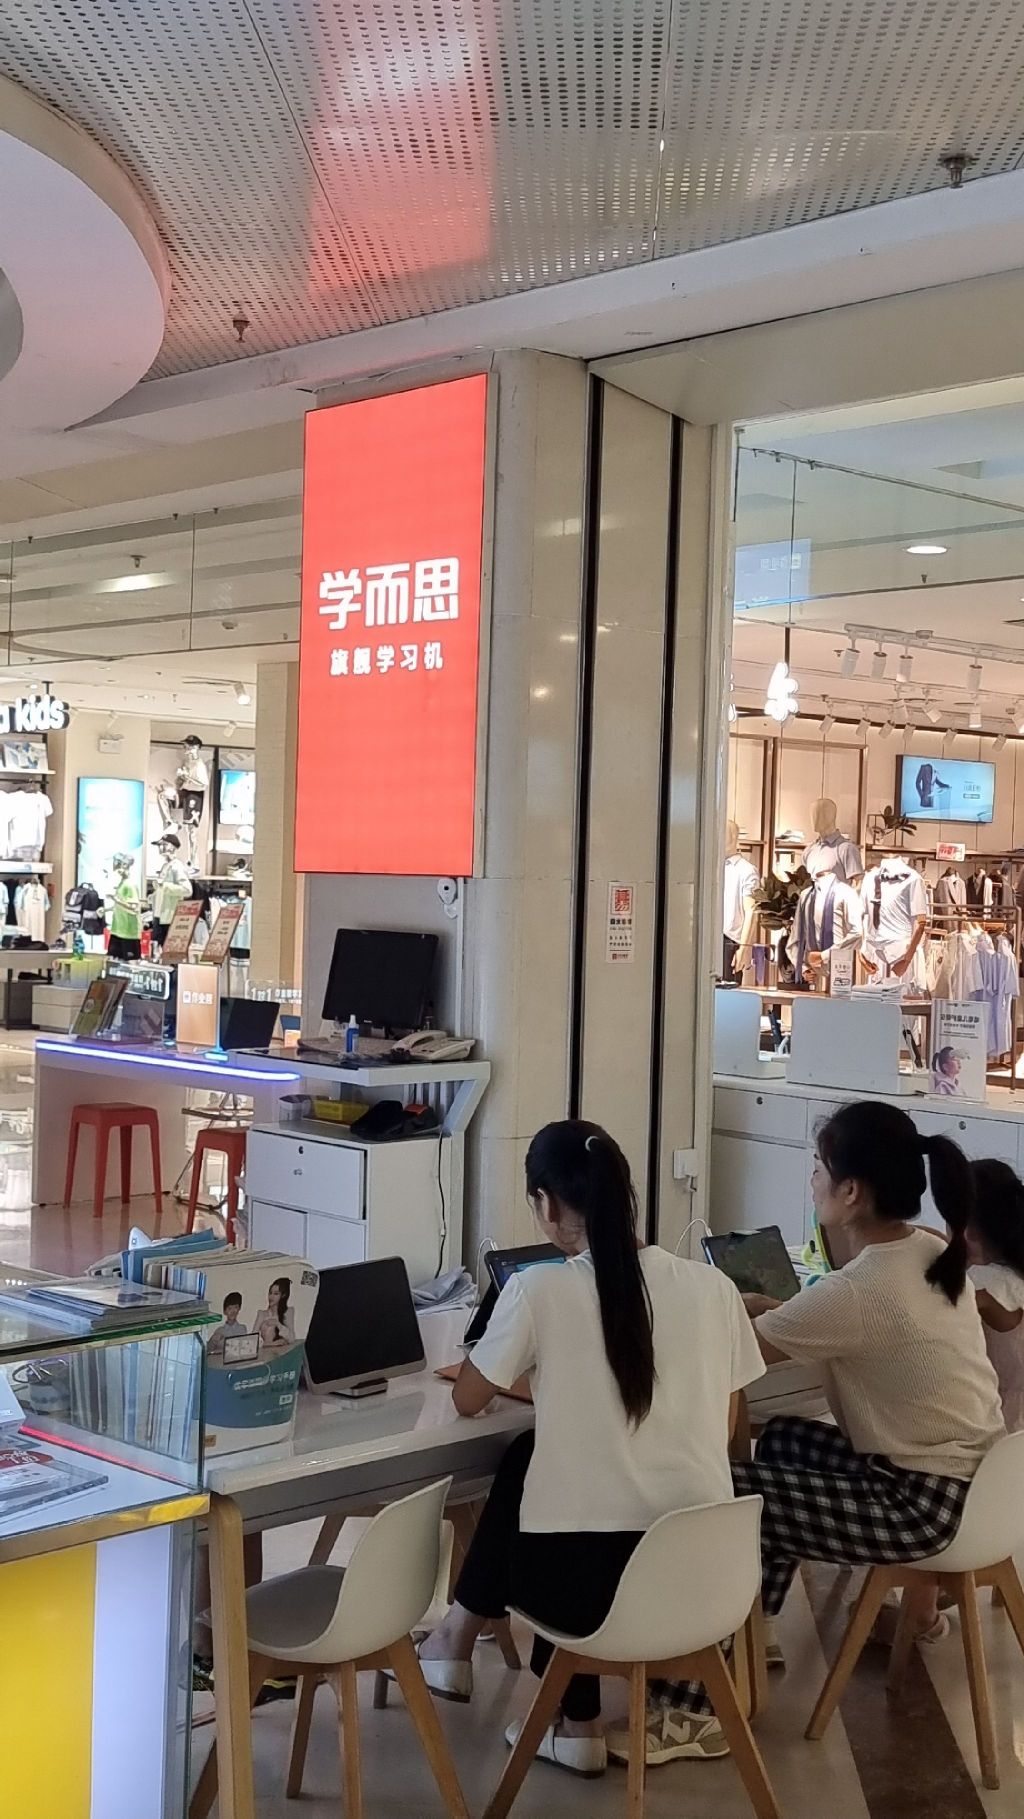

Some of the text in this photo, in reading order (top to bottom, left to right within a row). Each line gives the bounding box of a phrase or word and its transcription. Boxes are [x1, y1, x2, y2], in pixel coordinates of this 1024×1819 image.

[319, 557, 459, 630] 学而思
[330, 642, 443, 675] 旗舰学习机
[15, 694, 65, 732] kids
